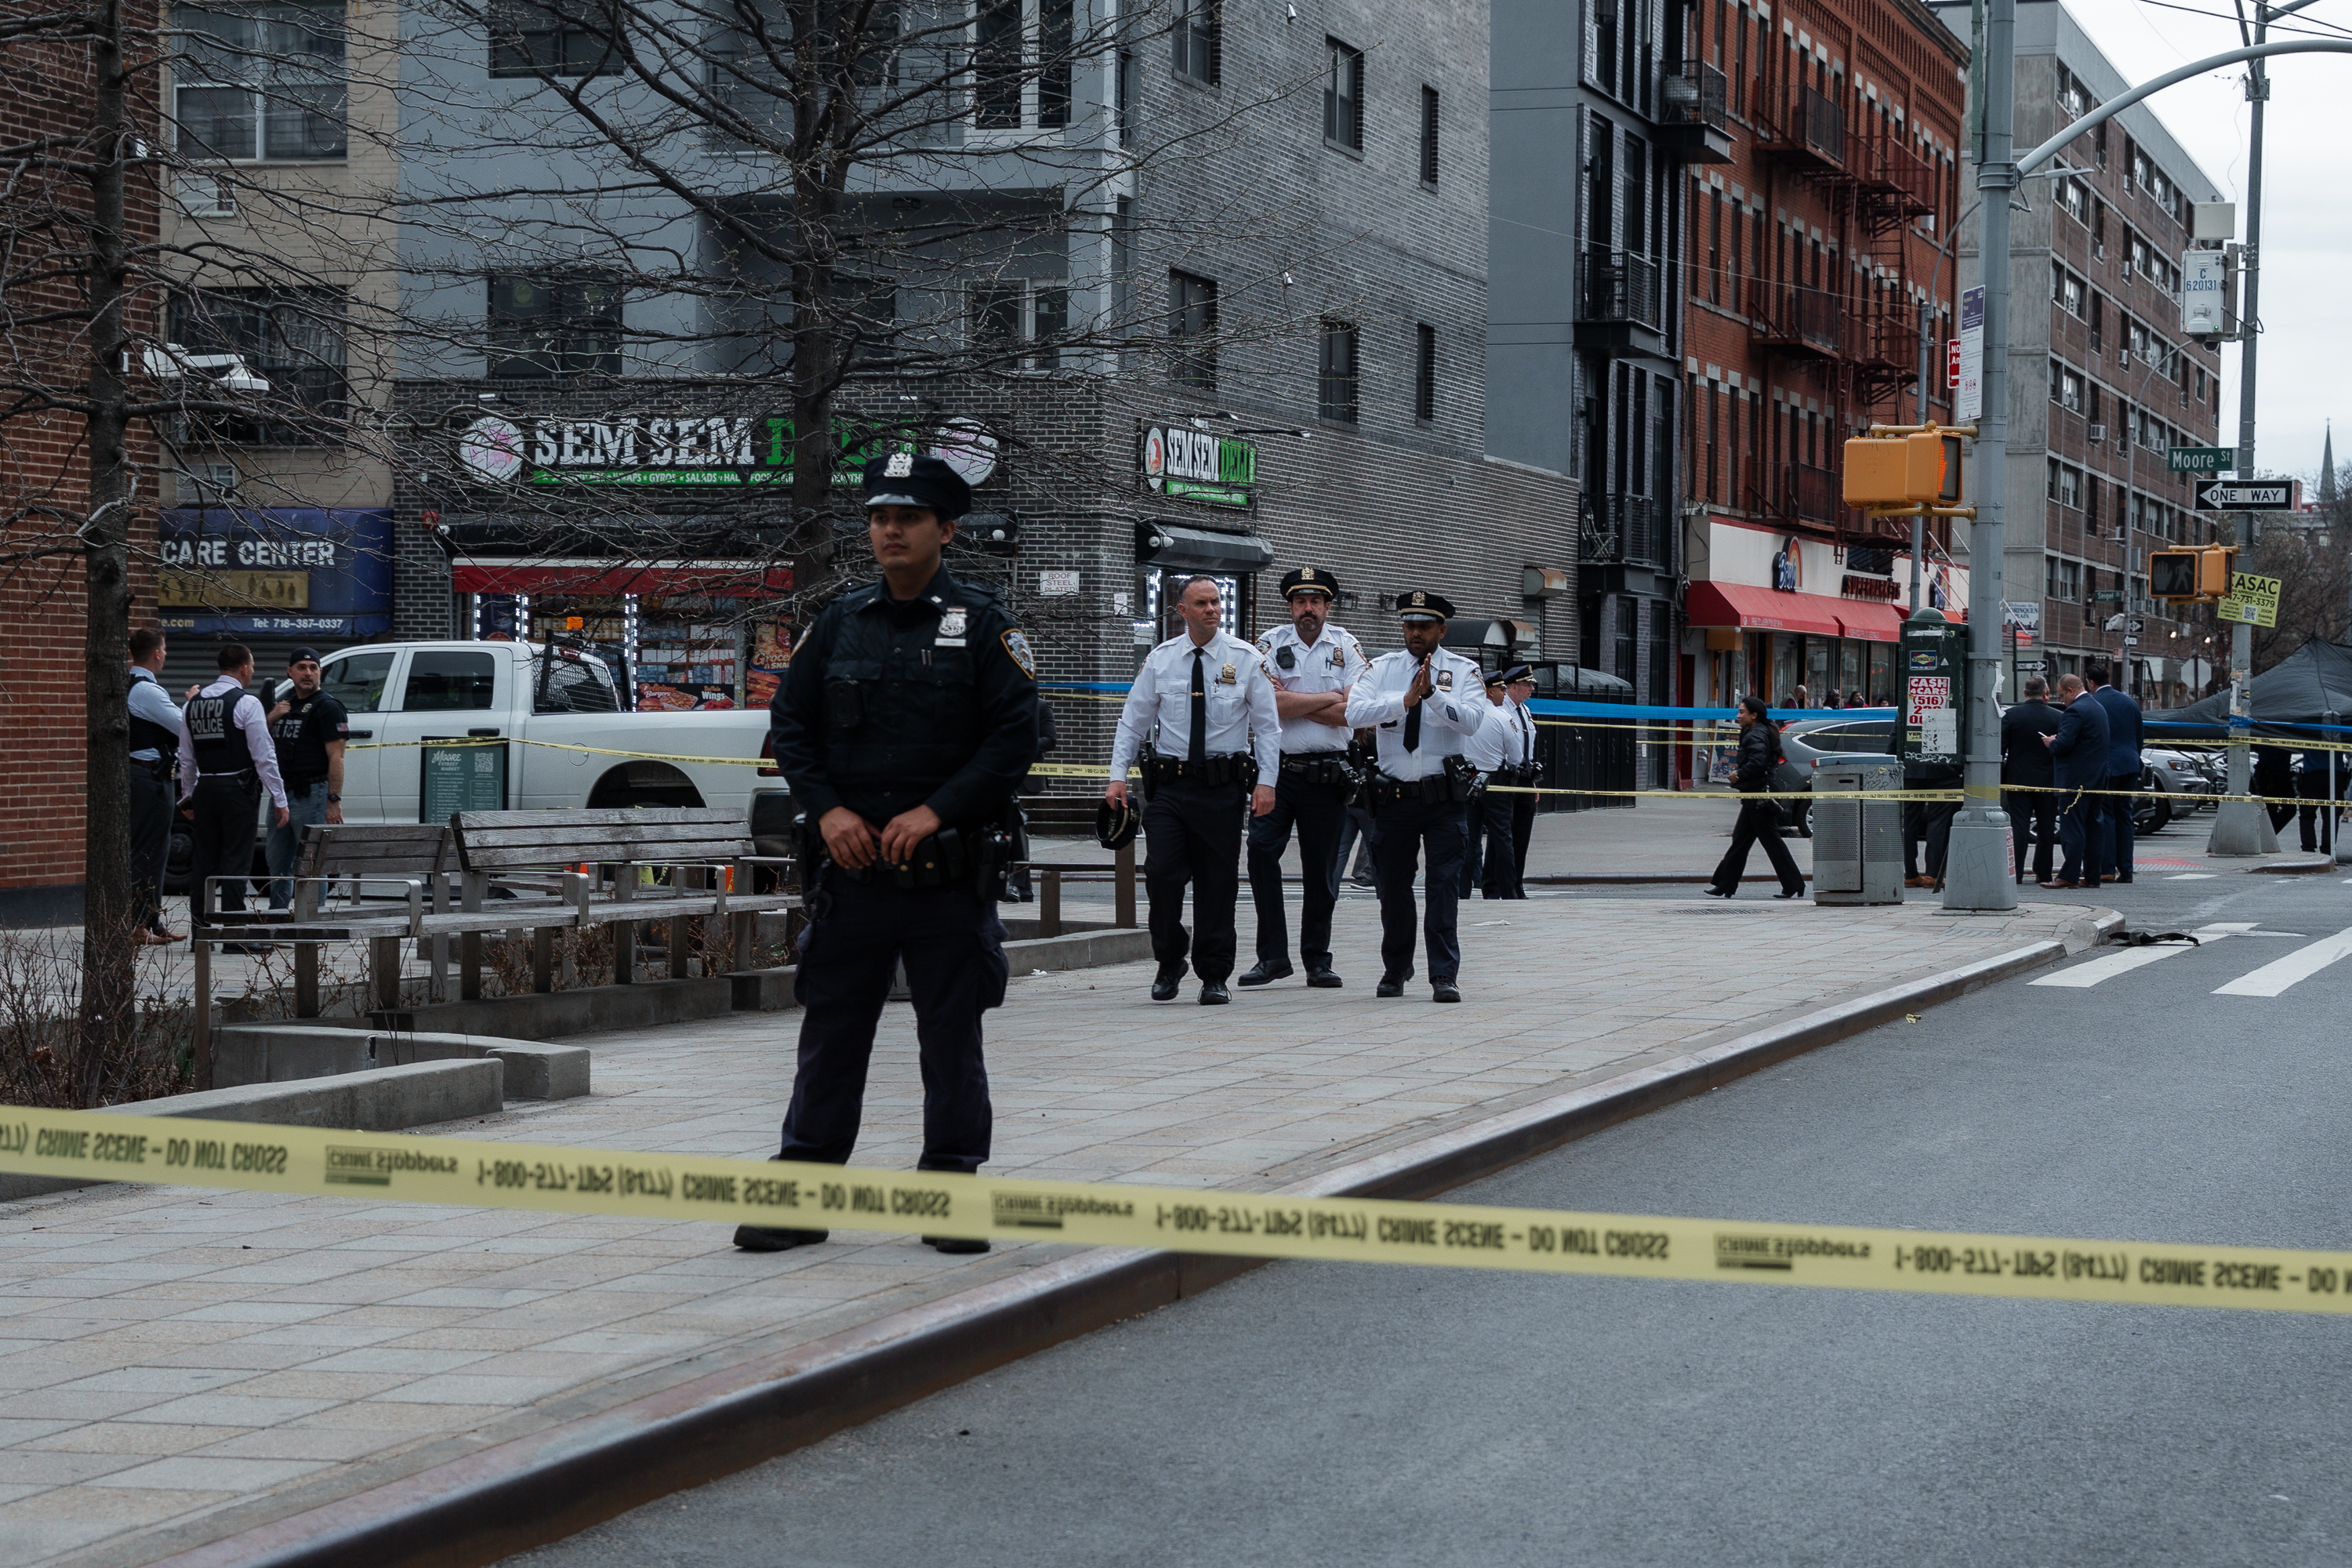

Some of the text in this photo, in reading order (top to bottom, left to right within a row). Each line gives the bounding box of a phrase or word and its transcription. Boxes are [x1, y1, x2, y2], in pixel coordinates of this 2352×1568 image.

[2200, 269, 2206, 279] C
[2186, 280, 2216, 291] 620131
[535, 417, 639, 466] SEM
[649, 417, 755, 466] SEM
[1220, 437, 1248, 485] DELI
[2172, 451, 2230, 468] Moore St
[649, 473, 677, 483] GYROS
[685, 473, 717, 483] SALADS
[724, 473, 743, 483] HAL
[2210, 490, 2280, 502] ONE WAY
[159, 541, 336, 566] CARE CENTER
[2232, 573, 2279, 595] ASAC
[274, 618, 343, 628] 718-387-0337
[639, 683, 677, 693] Delicious
[701, 690, 726, 701] Wings
[1912, 695, 1944, 706] (516)
[190, 699, 224, 720] NYPD
[190, 717, 225, 734] POLICE
